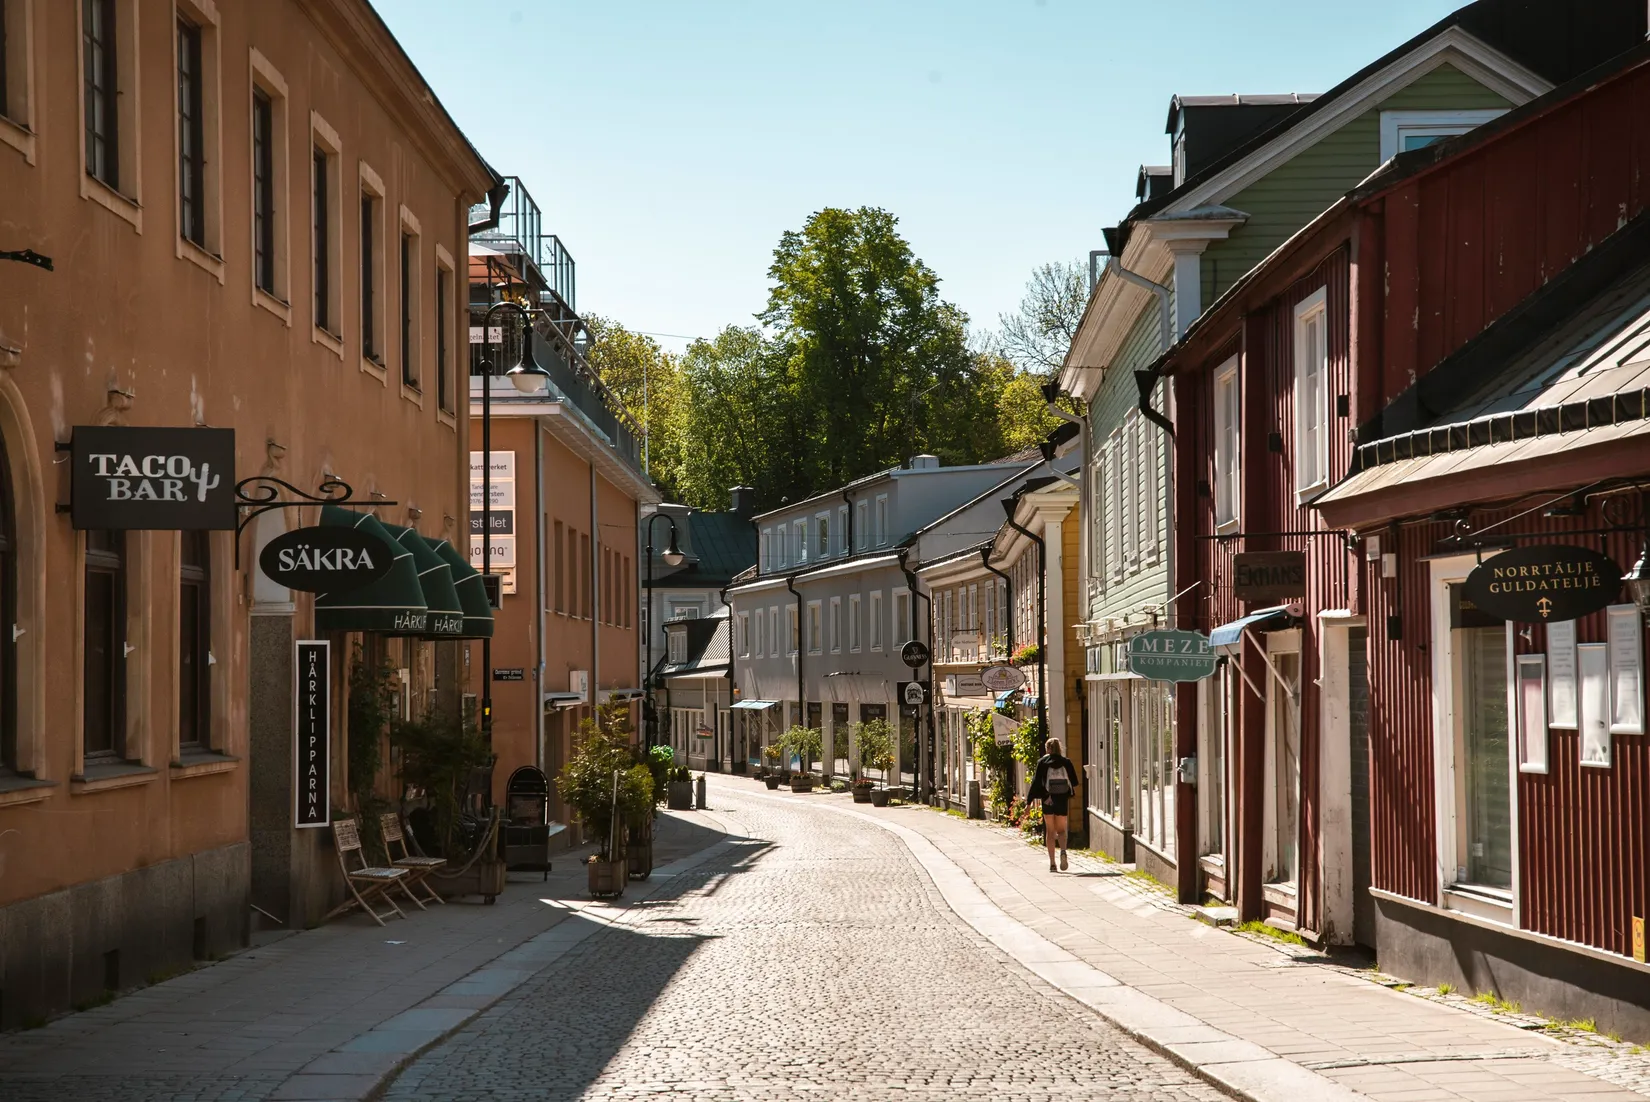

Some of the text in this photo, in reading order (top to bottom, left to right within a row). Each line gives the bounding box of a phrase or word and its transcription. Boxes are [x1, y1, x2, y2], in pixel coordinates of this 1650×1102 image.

[89, 454, 191, 478] TACO
[106, 478, 188, 502] BAR
[278, 544, 375, 571] SÄKRA
[1494, 561, 1594, 579] NORRTÄLJE
[1489, 574, 1601, 594] GULDATELJÉ
[1141, 638, 1210, 654] MEZE
[1140, 658, 1209, 667] KOMPANIET
[308, 651, 317, 818] HÅRKLIPPARNA
